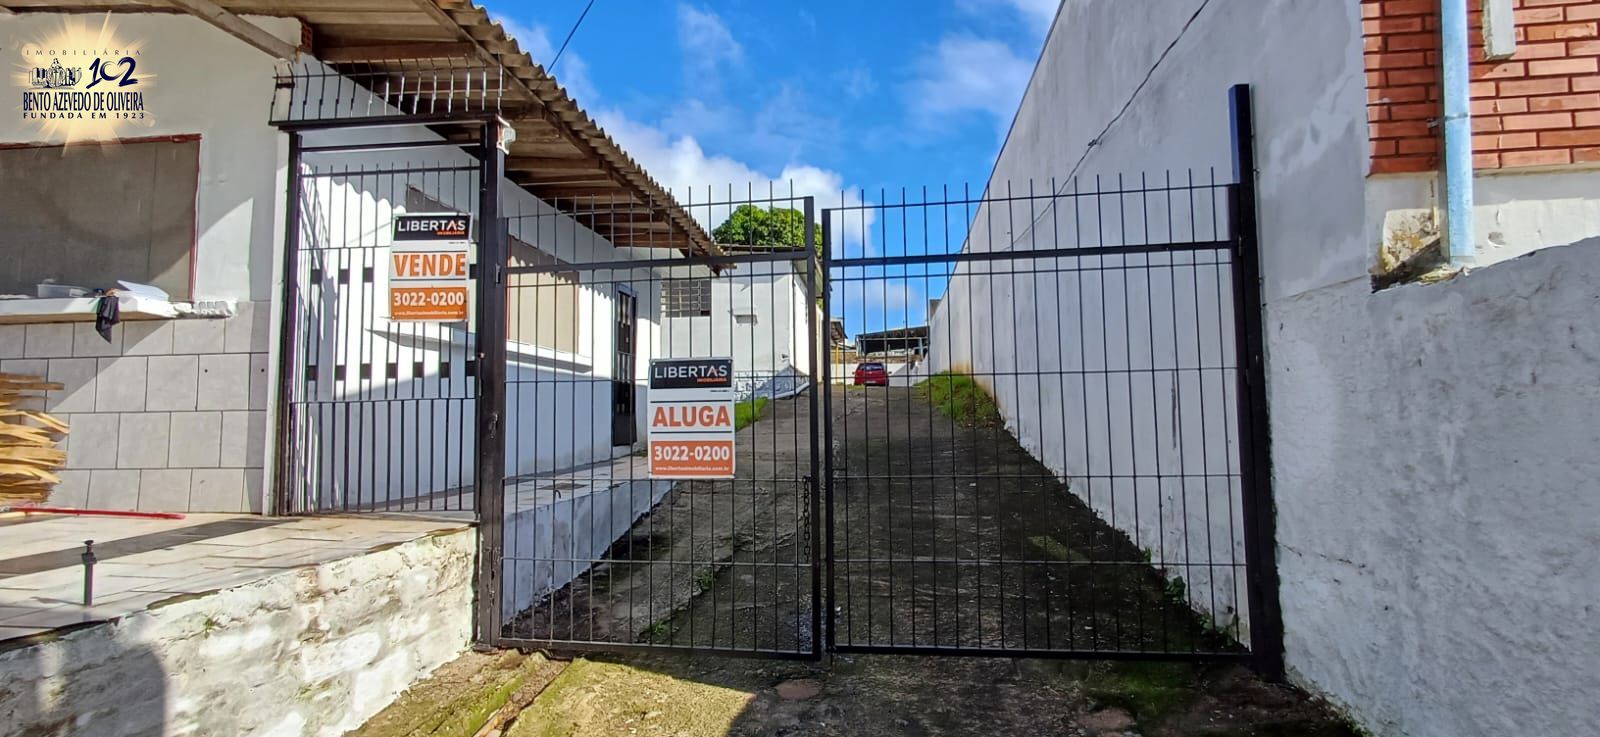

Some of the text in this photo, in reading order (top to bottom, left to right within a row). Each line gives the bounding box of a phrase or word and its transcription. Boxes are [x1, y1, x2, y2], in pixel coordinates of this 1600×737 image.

[397, 219, 466, 232] LIBERTAS
[393, 253, 466, 277] VENDE
[393, 291, 465, 306] 3022-0200
[654, 364, 728, 379] LIBERTAS
[652, 405, 731, 427] ALUGA
[654, 445, 730, 461] 3022-0200
